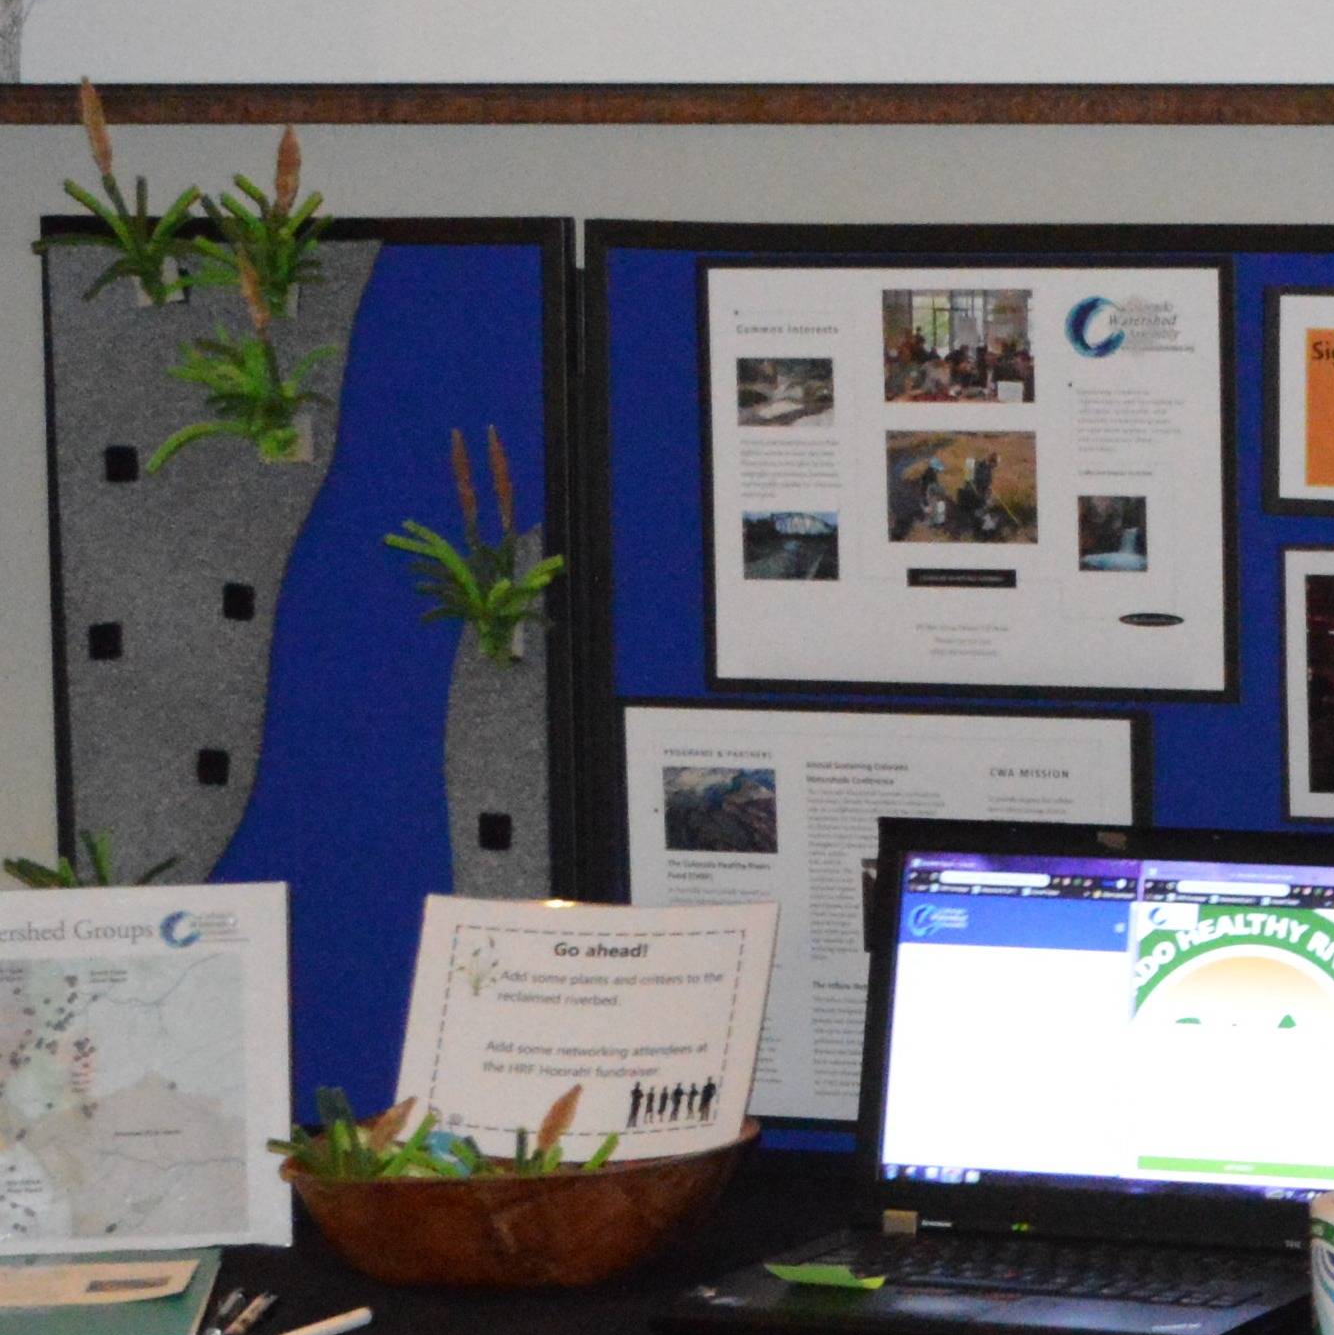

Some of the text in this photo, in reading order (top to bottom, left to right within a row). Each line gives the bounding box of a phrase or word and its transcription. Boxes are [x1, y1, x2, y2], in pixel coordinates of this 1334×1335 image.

[1020, 768, 1069, 779] MISSION
[74, 918, 154, 945] Groups
[1175, 913, 1310, 952] HEALTHY
[554, 941, 649, 958] Go ahead!
[501, 970, 528, 983] Add
[532, 973, 567, 984] some
[570, 973, 609, 987] plants
[613, 974, 637, 985] and
[687, 973, 701, 984] to
[703, 971, 724, 983] the
[486, 1040, 513, 1053] Add
[517, 1044, 553, 1055] some
[557, 1044, 628, 1060] networking
